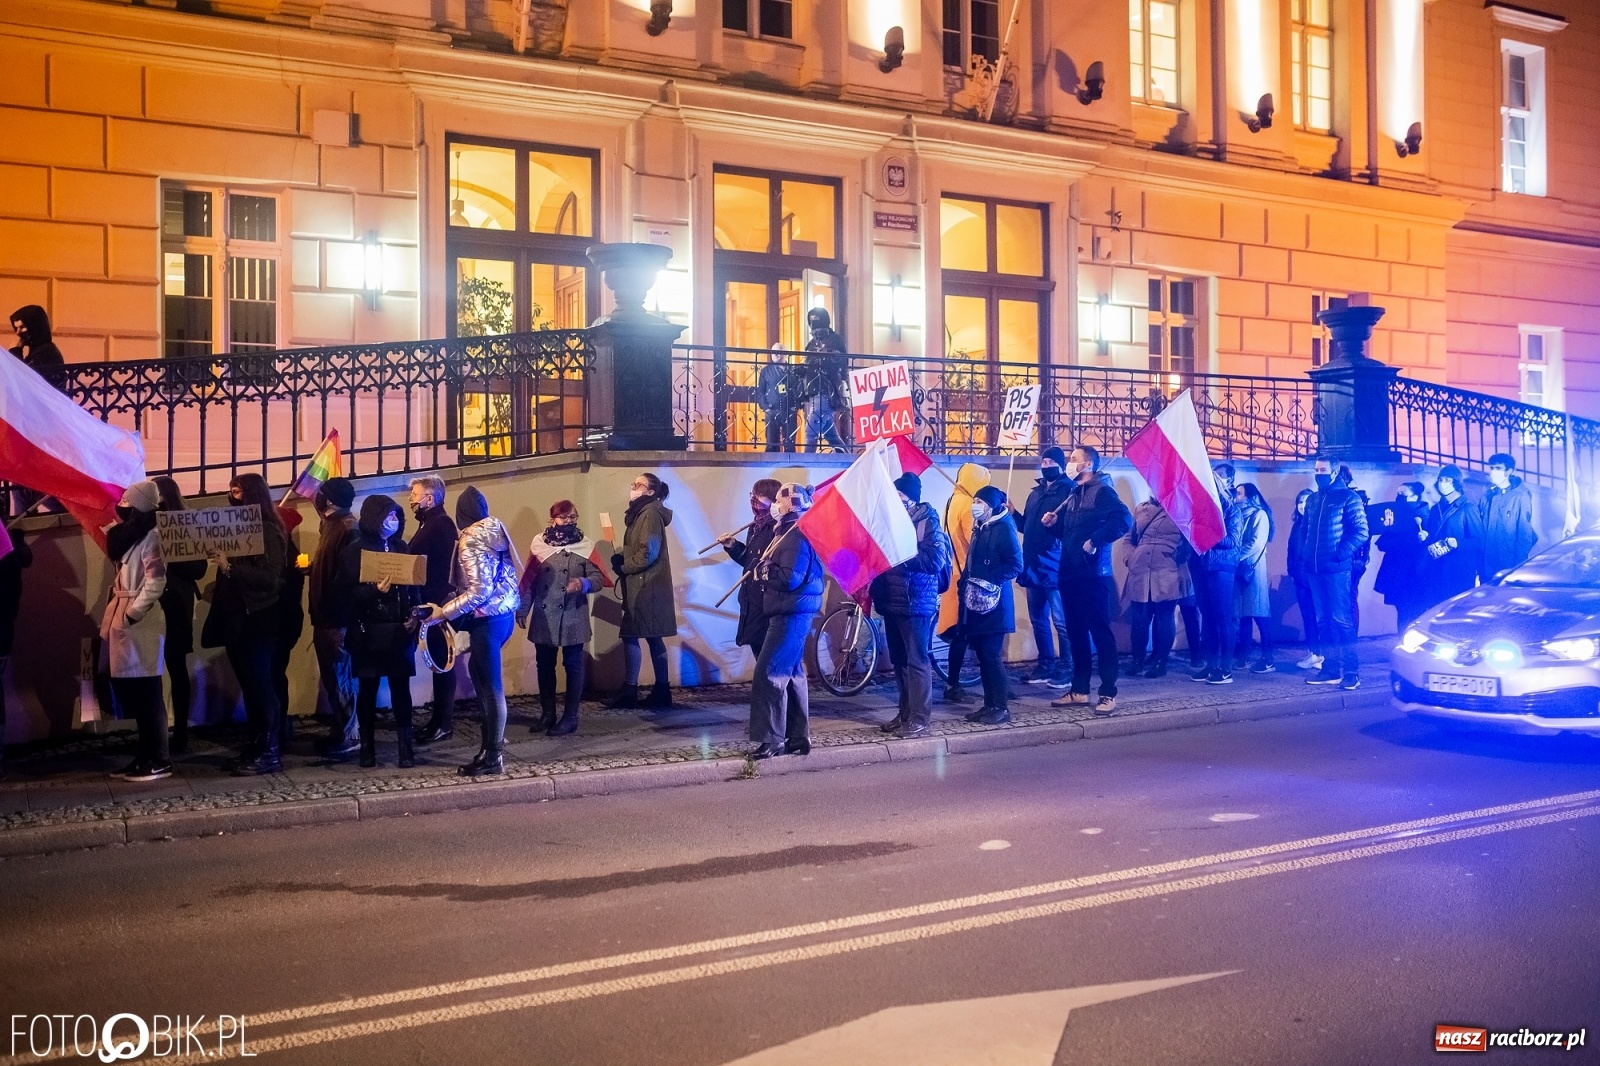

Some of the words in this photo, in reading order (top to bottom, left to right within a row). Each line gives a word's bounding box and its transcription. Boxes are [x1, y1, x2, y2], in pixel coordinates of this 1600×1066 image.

[854, 365, 908, 394] WOLNA
[1009, 387, 1034, 409] PIS
[859, 410, 913, 438] POLKA
[1003, 411, 1034, 432] OFF!
[203, 510, 220, 524] TO
[225, 507, 260, 523] TWOJA
[160, 527, 191, 541] WINA
[195, 525, 234, 539] TWOJA
[160, 540, 209, 557] WIELKA
[214, 539, 241, 552] WINA
